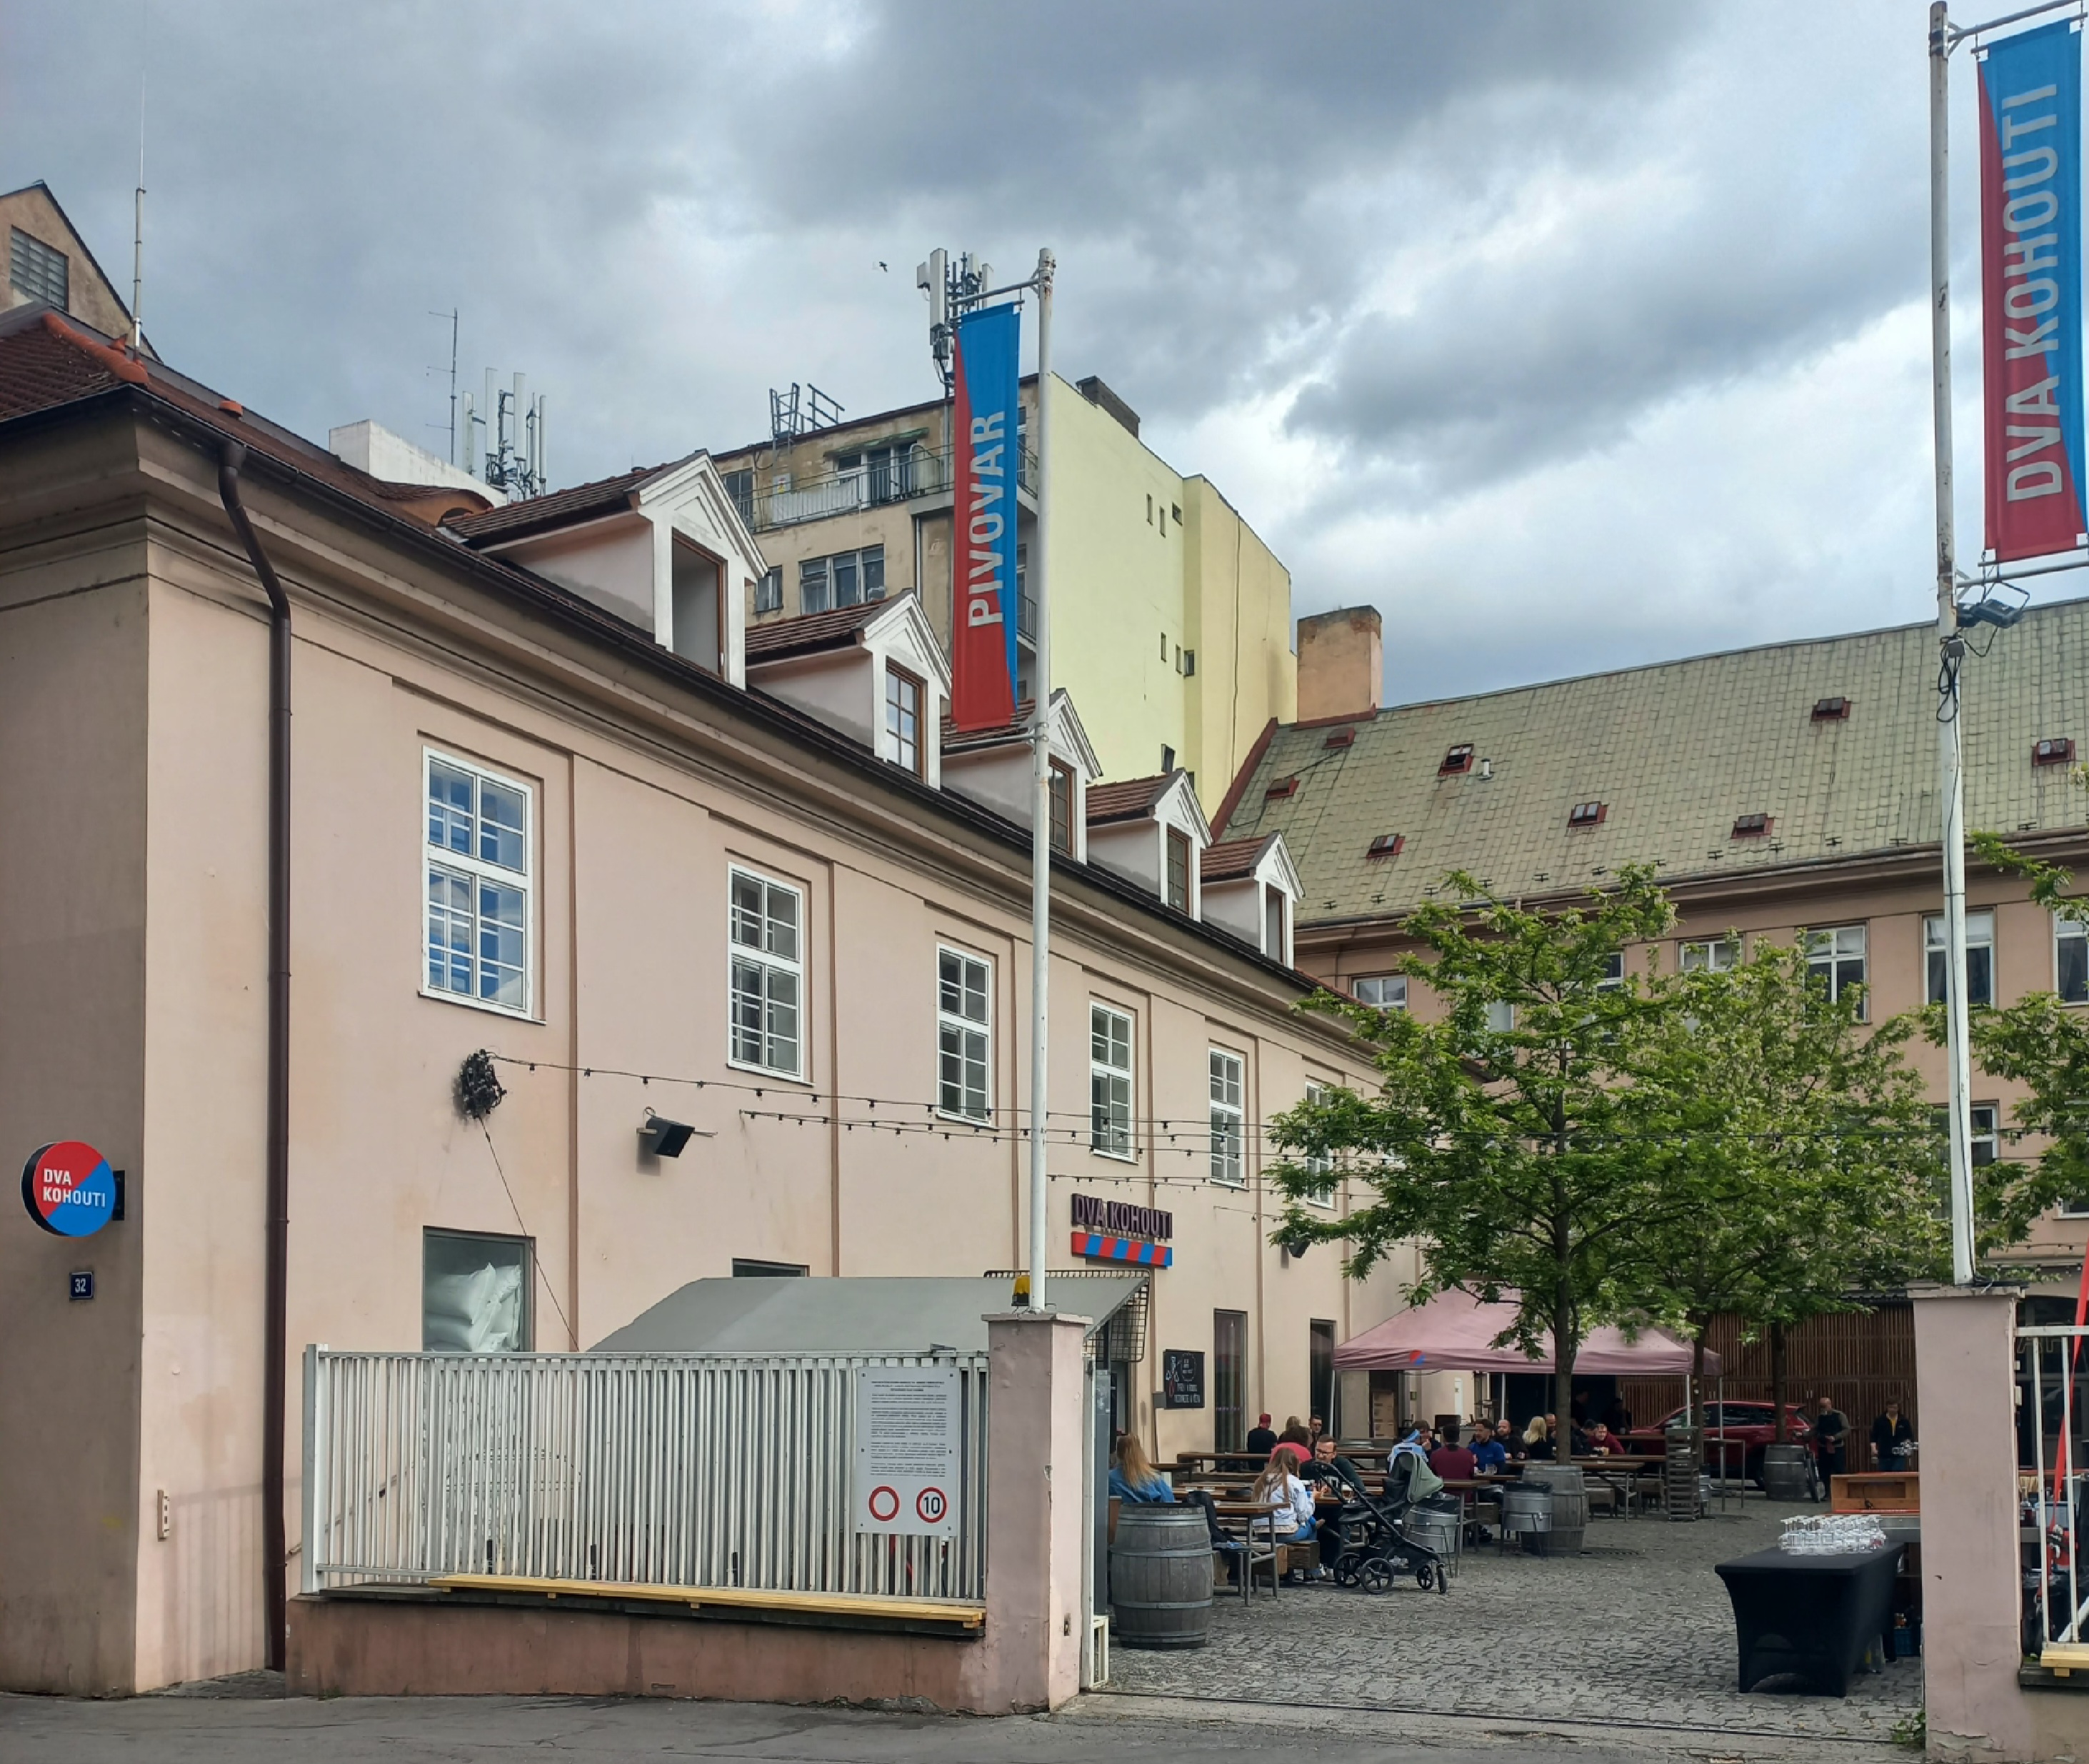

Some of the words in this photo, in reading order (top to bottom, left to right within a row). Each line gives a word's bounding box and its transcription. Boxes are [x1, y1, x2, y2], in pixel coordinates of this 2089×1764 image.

[2002, 84, 2059, 361] KOHOUTI
[2005, 374, 2063, 502] DVA
[967, 410, 1006, 628] PIVOVAR
[44, 1168, 72, 1186] DVA
[43, 1186, 106, 1208] KOHOUTI
[1072, 1193, 1106, 1226] DVA
[1108, 1201, 1173, 1239] KOHOUTI
[74, 1278, 86, 1293] 32
[923, 1495, 941, 1515] 10
